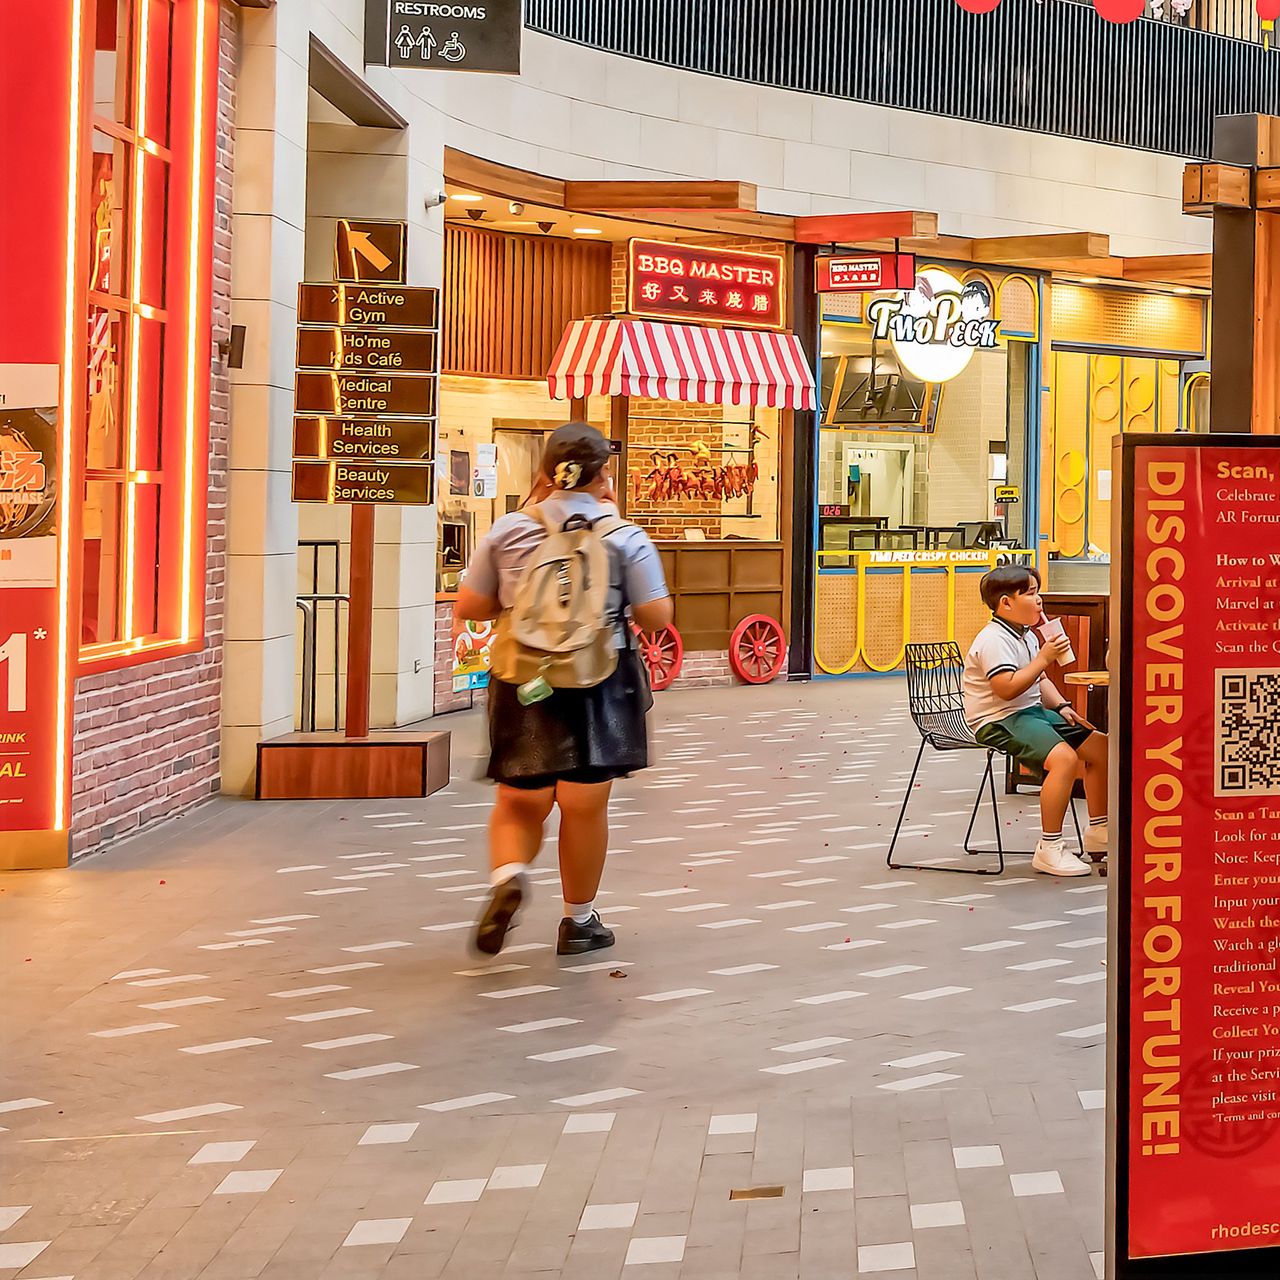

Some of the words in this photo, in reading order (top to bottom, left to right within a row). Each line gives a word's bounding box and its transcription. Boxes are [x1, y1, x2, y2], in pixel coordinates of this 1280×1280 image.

[395, 1, 486, 20] RESTROOMS
[638, 254, 684, 277] BBQ
[689, 260, 774, 287] MASTER
[848, 263, 879, 272] MASTER
[357, 290, 405, 305] Active
[349, 308, 386, 324] Gym
[343, 334, 391, 348] Ho'me
[330, 351, 363, 365] Kds
[367, 352, 402, 366] Café
[337, 378, 392, 393] Medical
[336, 395, 387, 409] Centre
[342, 423, 392, 437] Health
[332, 440, 399, 455] Services
[337, 467, 390, 485] Beauty
[1216, 461, 1274, 482] Scan,
[332, 485, 395, 499] Services
[1216, 510, 1237, 523] AR
[915, 551, 947, 563] CRISPY
[949, 550, 989, 562] CHICKEN
[1216, 553, 1248, 566] How
[1252, 557, 1265, 566] to
[1215, 575, 1261, 588] Arrival
[1265, 578, 1276, 587] at
[1142, 461, 1186, 726] DISCOVER
[1215, 619, 1268, 631] Activate
[1215, 640, 1244, 653] Scan
[1249, 640, 1268, 652] the
[1143, 736, 1184, 884] YOUR
[1214, 808, 1244, 820] Scan
[1247, 811, 1255, 819] a
[1214, 873, 1249, 886] Enter
[1213, 915, 1255, 929] Watch
[1259, 915, 1280, 927] the
[1213, 957, 1276, 973] traditional
[1213, 981, 1255, 995] Reveal
[1141, 895, 1183, 1156] FORTUNE!
[1212, 1025, 1258, 1039] Collect
[1212, 1091, 1248, 1109] please
[1251, 1089, 1276, 1102] visit
[1247, 1110, 1264, 1120] and
